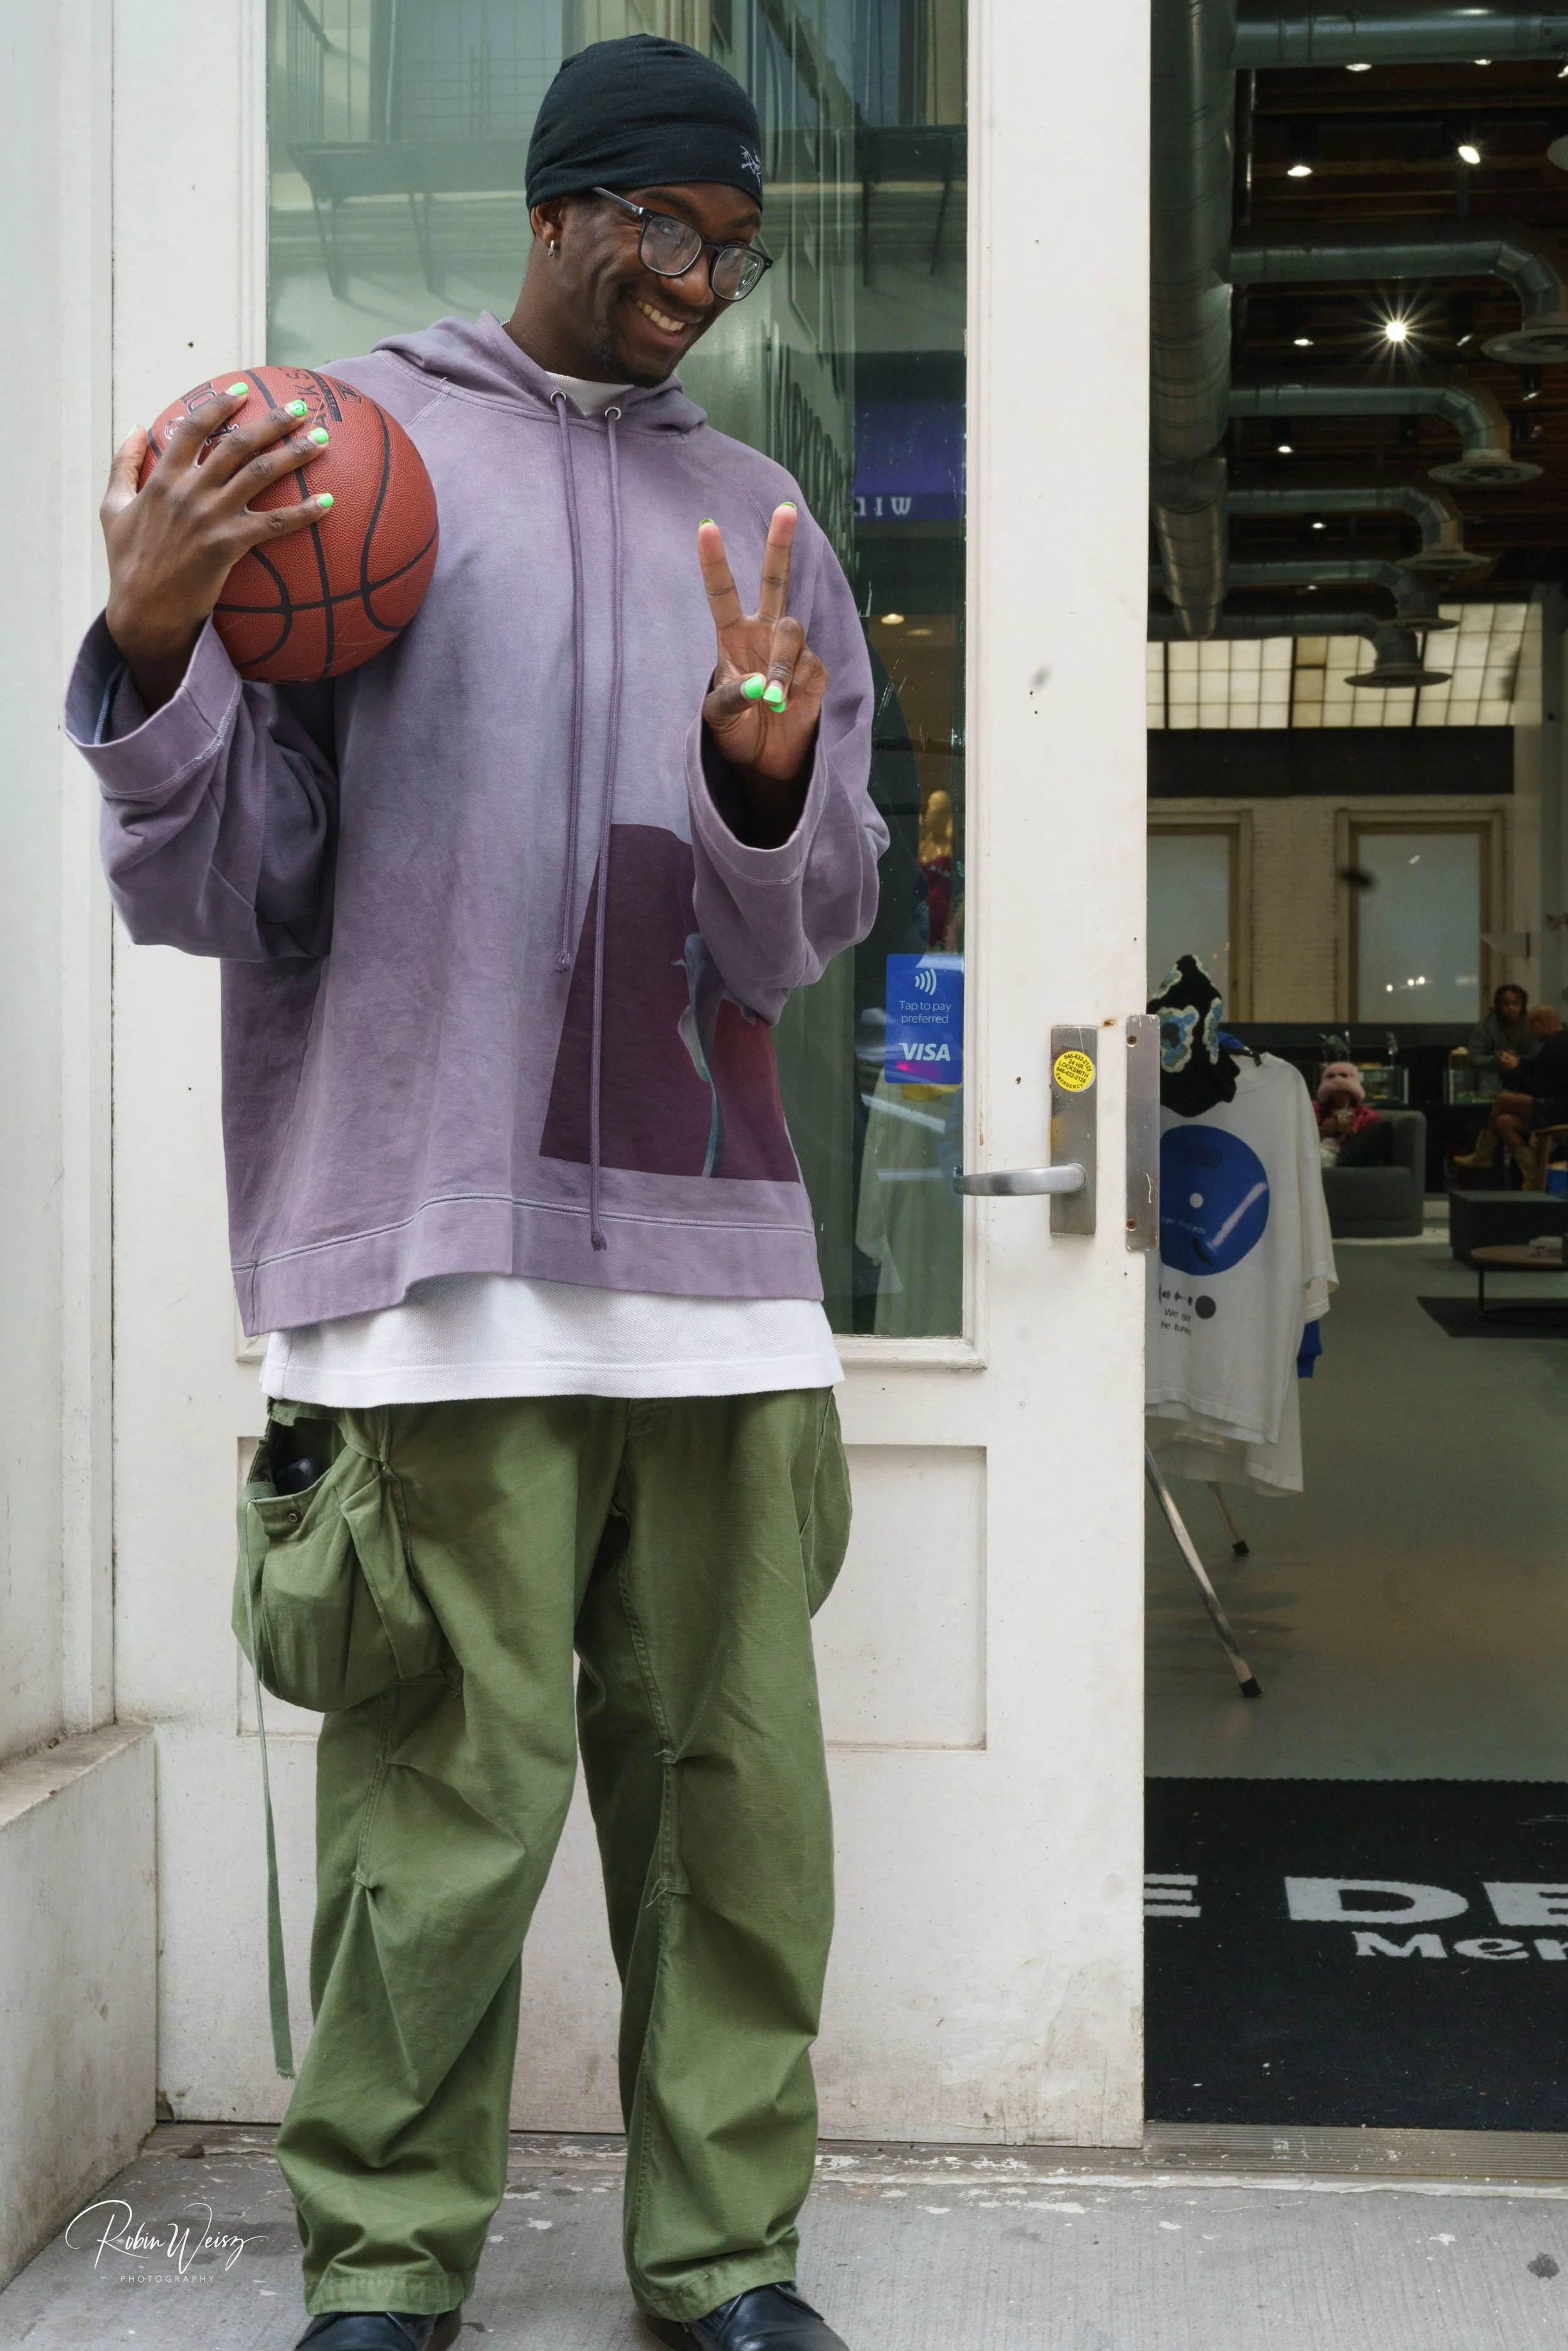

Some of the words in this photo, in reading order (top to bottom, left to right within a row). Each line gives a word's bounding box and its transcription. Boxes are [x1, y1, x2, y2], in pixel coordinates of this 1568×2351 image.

[899, 1000, 918, 1012] Tap
[920, 1001, 931, 1011] to
[933, 1003, 951, 1013] pay
[901, 1014, 949, 1024] preferred
[898, 1043, 951, 1061] VISA
[1058, 1061, 1089, 1078] LOCKSMITH
[1064, 1053, 1092, 1072] 646-632-2128
[1055, 1073, 1083, 1089] EMERGENCY
[1056, 1066, 1086, 1084] 646-632-2128
